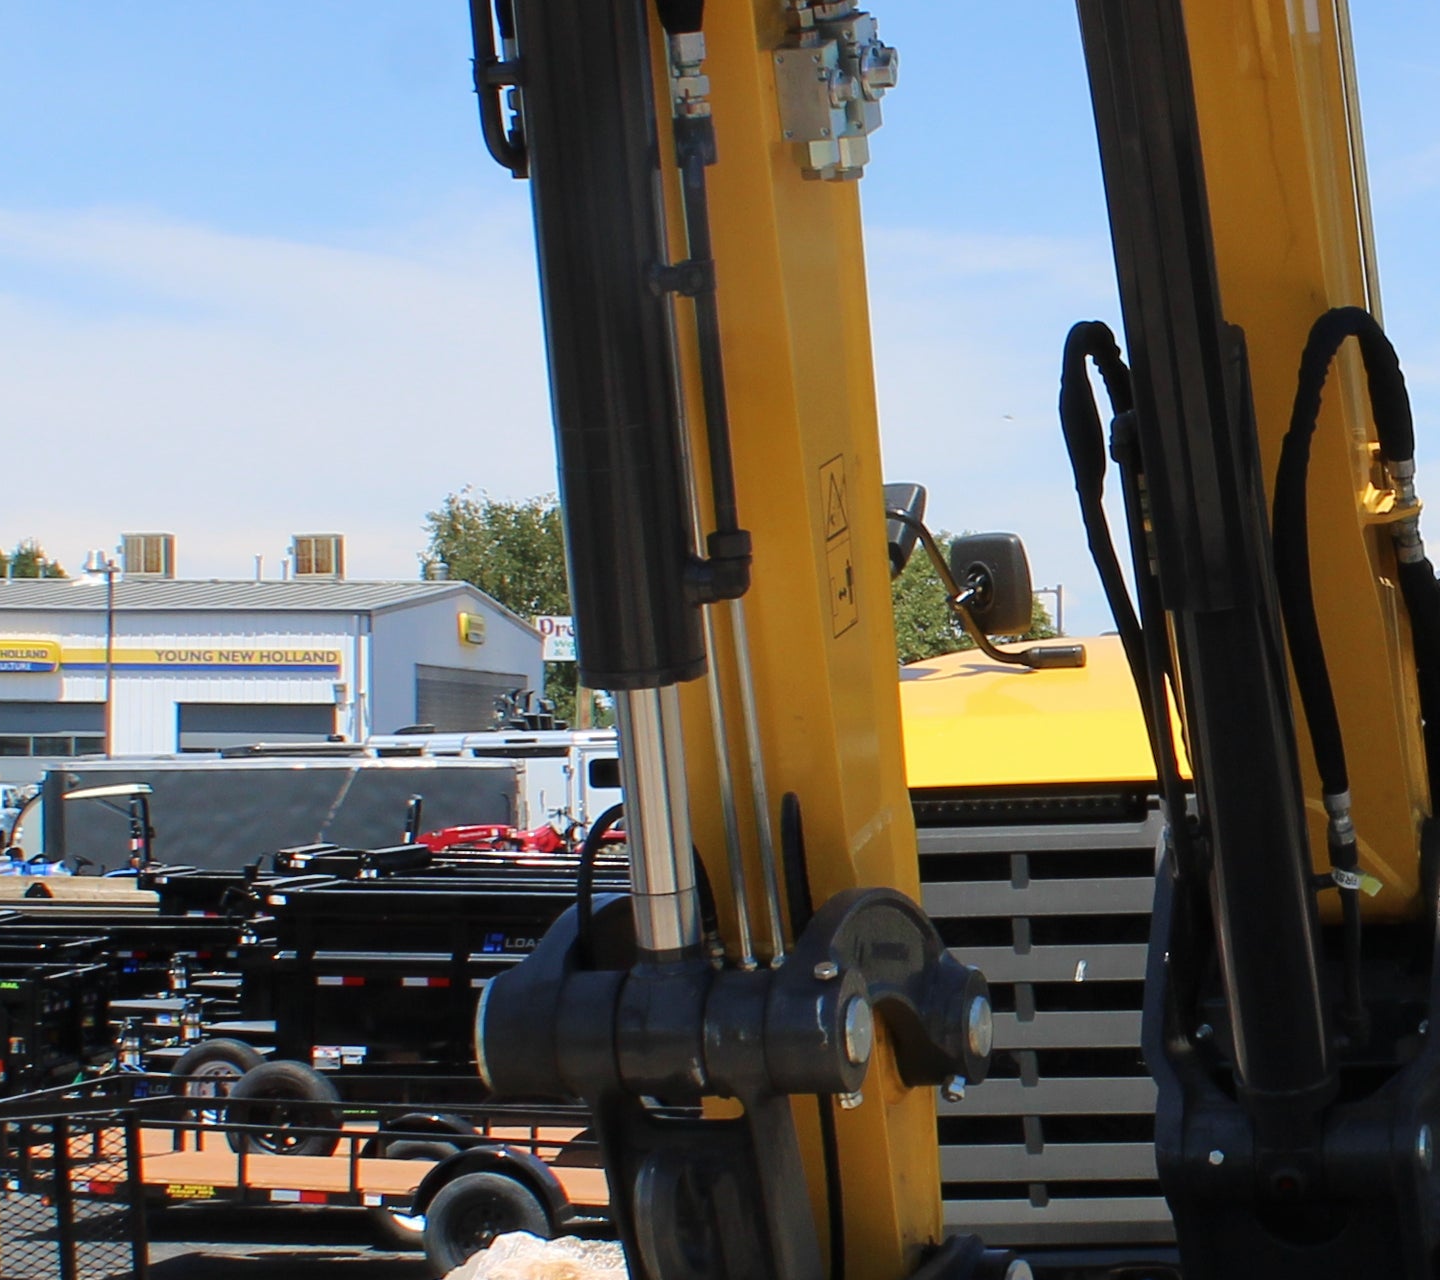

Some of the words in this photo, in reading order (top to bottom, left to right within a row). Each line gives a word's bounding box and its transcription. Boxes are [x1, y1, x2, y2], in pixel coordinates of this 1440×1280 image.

[0, 649, 49, 659] HOLLAND
[155, 650, 213, 662] YOUNG
[218, 650, 255, 662] NEW
[259, 650, 338, 663] HOLLAND
